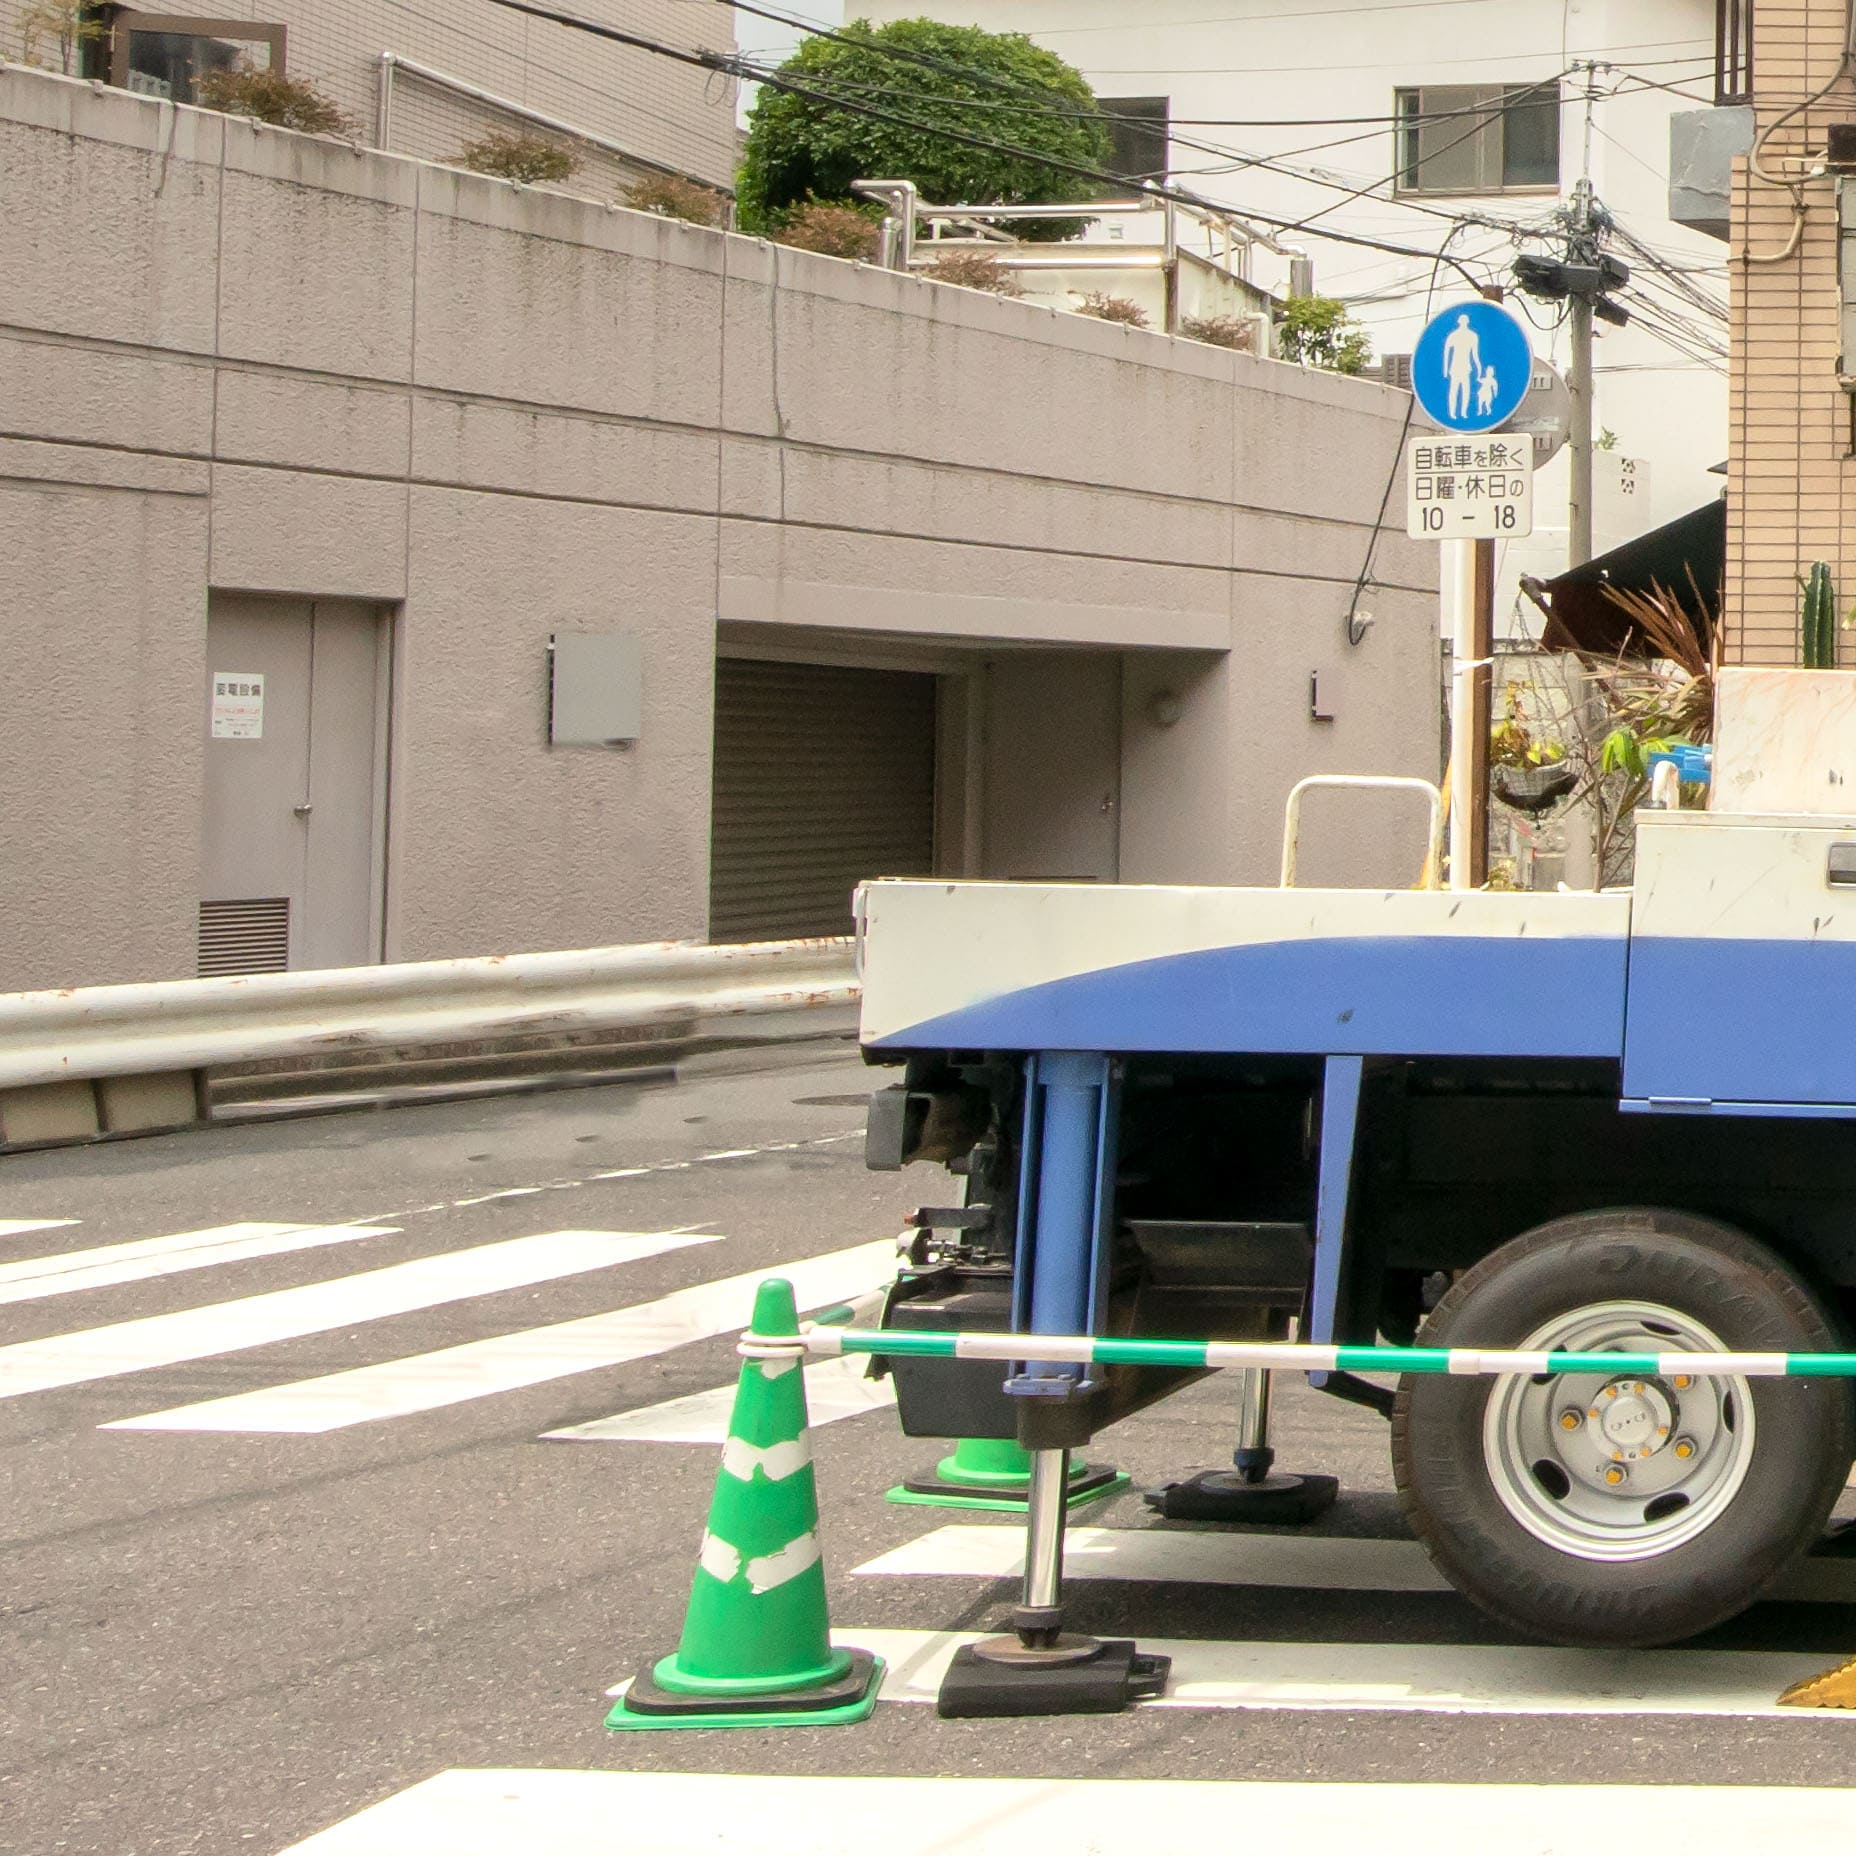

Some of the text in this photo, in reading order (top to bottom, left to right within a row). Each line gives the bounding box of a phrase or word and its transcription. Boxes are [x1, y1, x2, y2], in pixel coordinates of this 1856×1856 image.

[1416, 443, 1523, 469] 自転車を除く
[1416, 473, 1524, 500] 日曜・休日の
[1422, 507, 1443, 531] 10
[1494, 504, 1516, 529] 18
